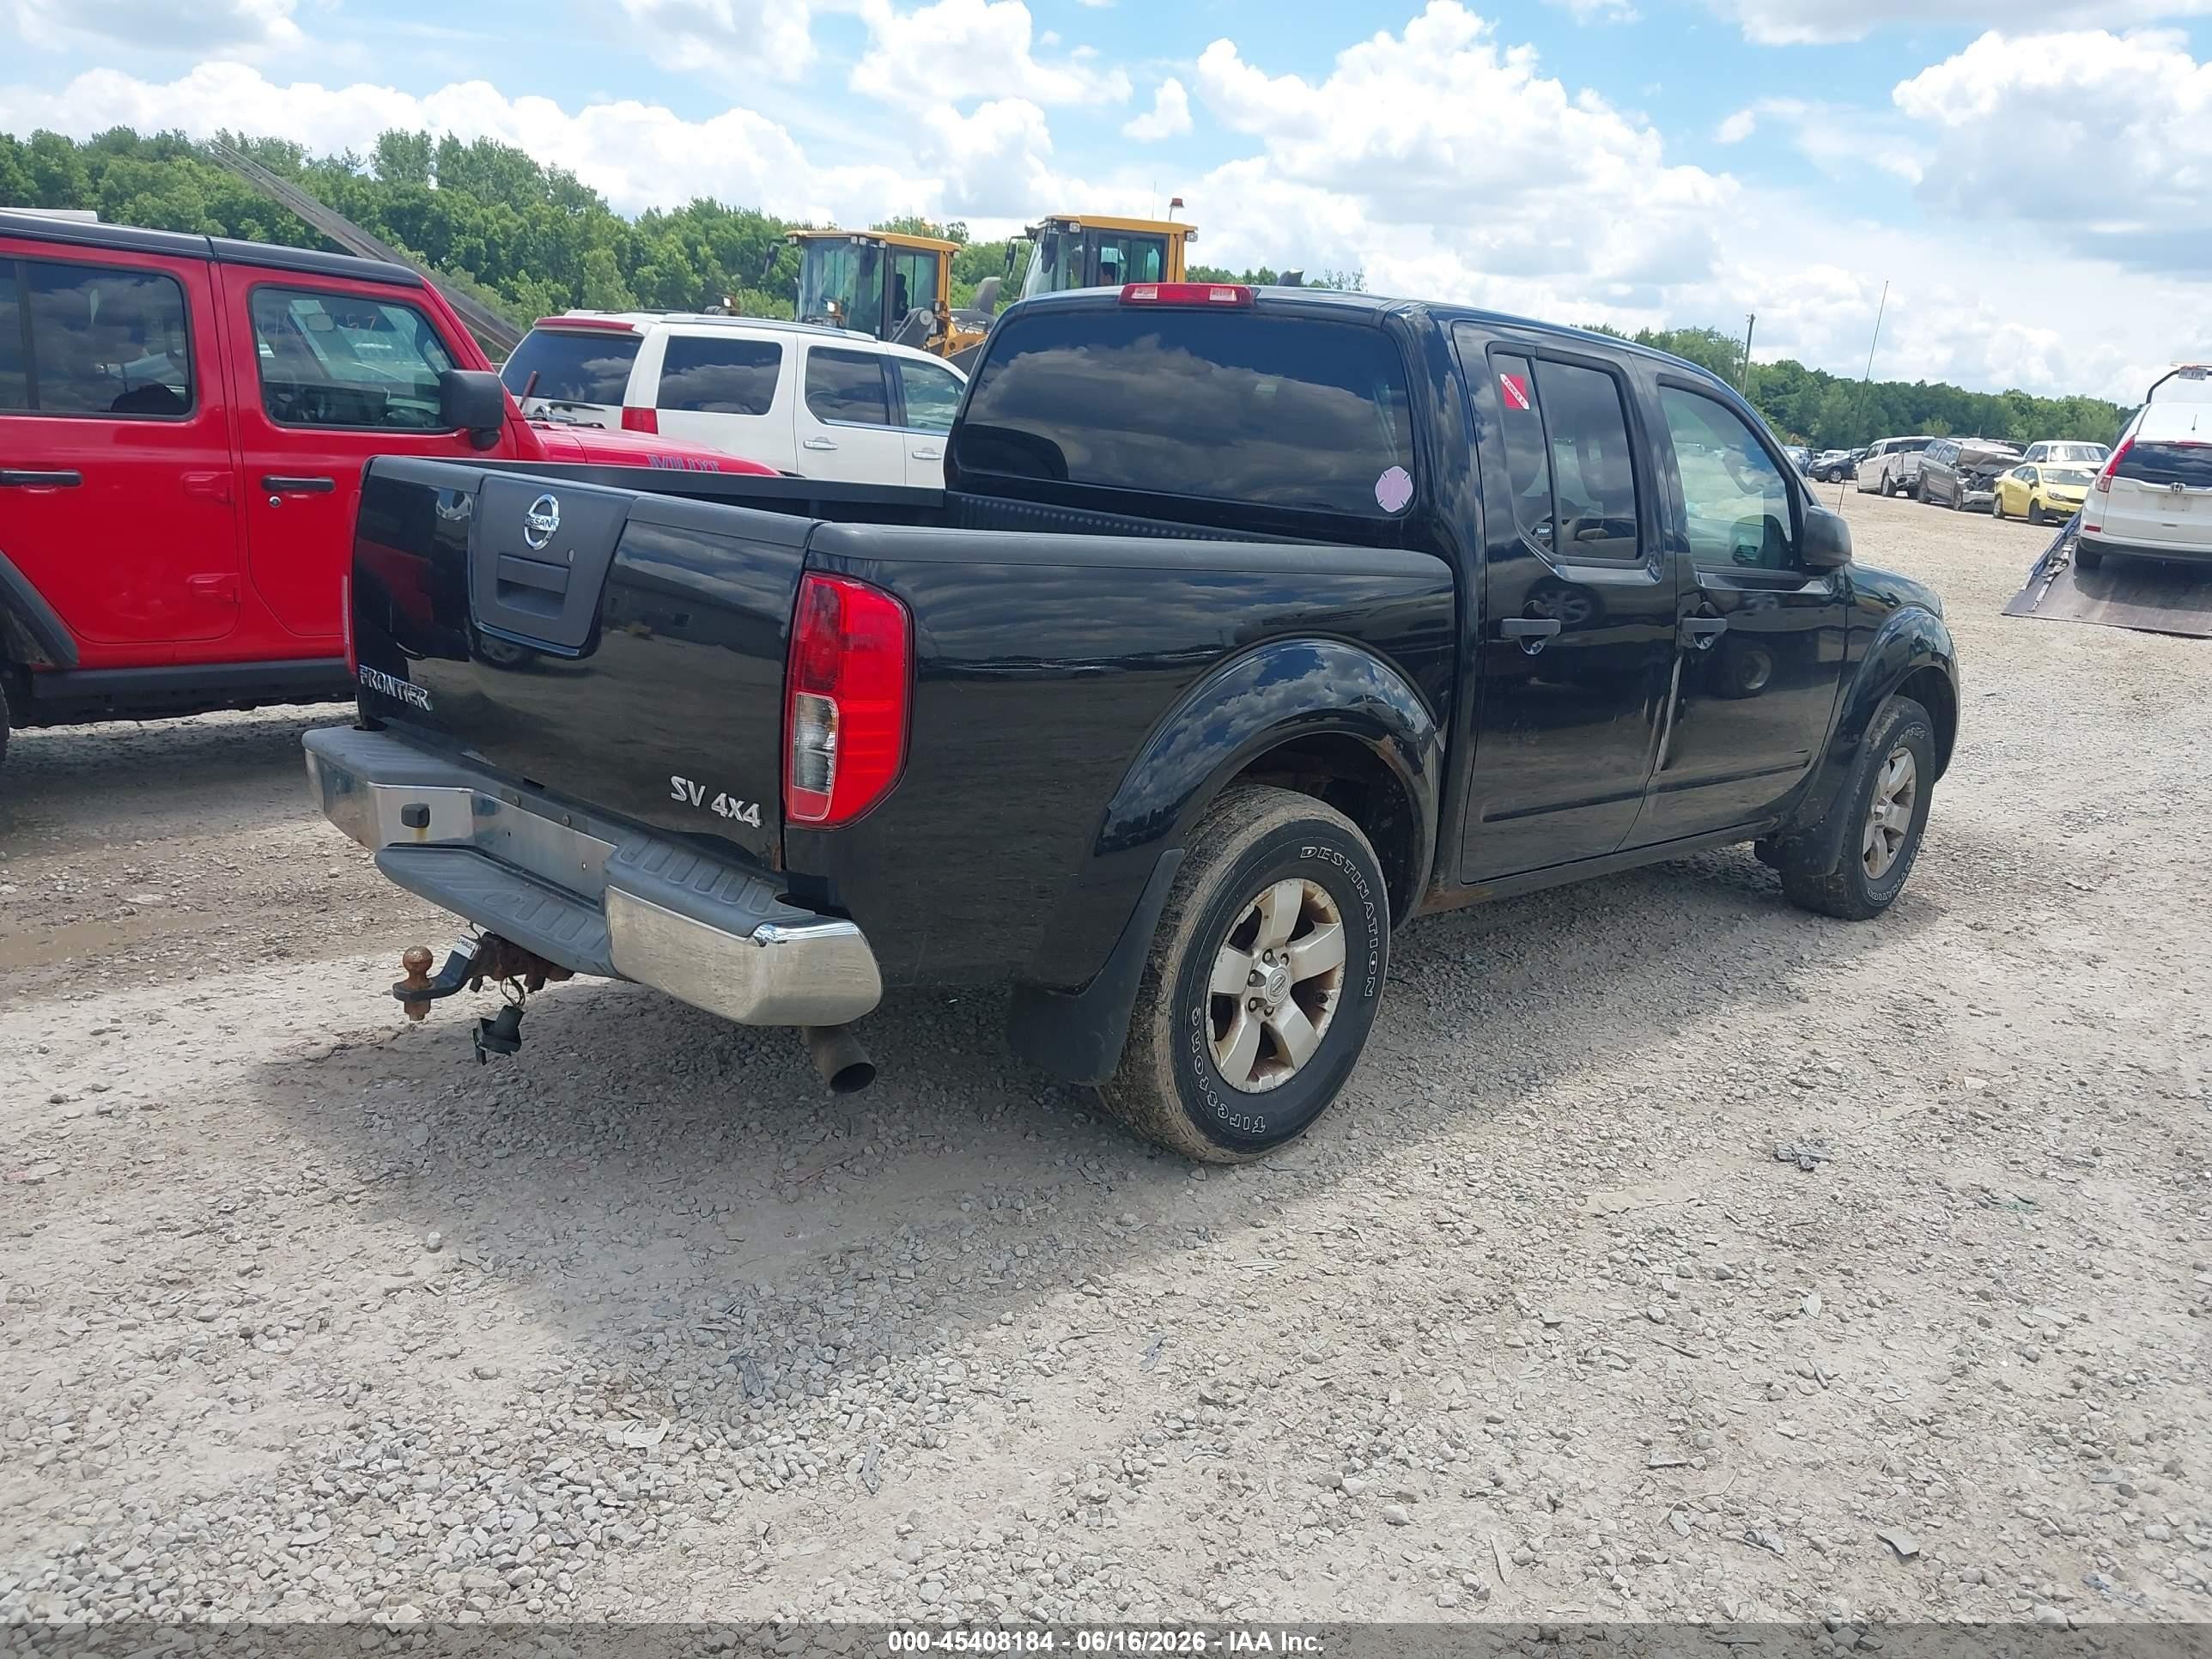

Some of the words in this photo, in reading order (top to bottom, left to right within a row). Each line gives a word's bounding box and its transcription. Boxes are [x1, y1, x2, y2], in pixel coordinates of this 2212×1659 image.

[359, 665, 431, 711] FRONTIER
[671, 775, 706, 807] SV
[1300, 846, 1378, 997] DESTINATION
